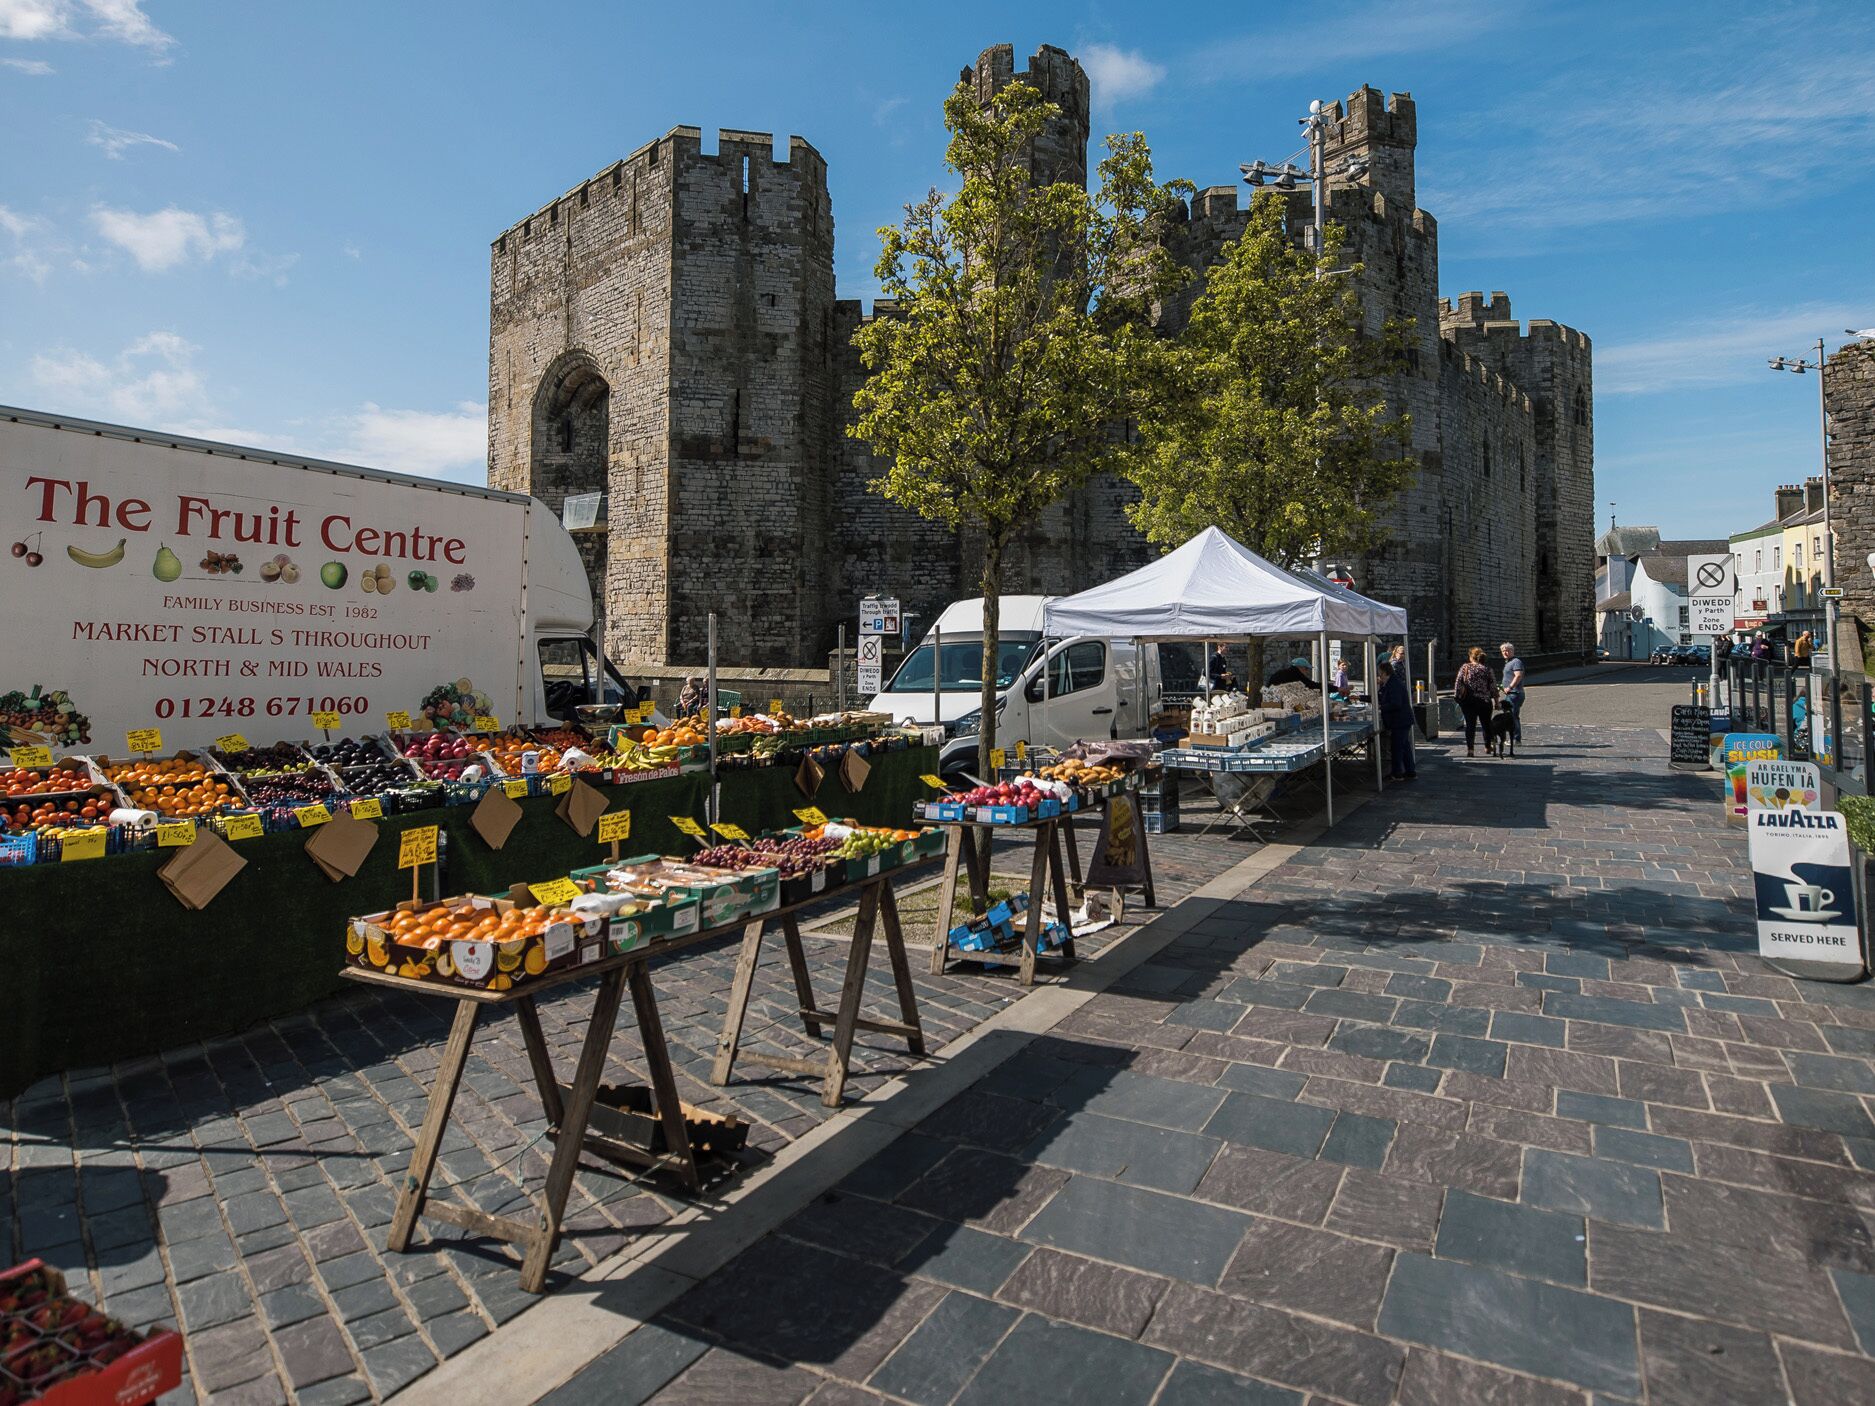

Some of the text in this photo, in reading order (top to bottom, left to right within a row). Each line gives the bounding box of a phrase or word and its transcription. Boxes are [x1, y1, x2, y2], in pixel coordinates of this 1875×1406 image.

[25, 476, 466, 564] The Fruit Centre
[163, 595, 378, 619] FAMILY BUSINESS EST 1982
[1692, 599, 1731, 607] DIWEDD
[72, 621, 184, 643] MARKET
[291, 630, 431, 649] THROUGHOUT
[1698, 623, 1725, 631] ENDS
[142, 658, 382, 678] NORTH & MID WALES
[155, 695, 370, 719] 01248 671060
[1733, 740, 1773, 750] ICE COLD
[1728, 749, 1778, 763] SLUSH
[1758, 763, 1807, 774] AR GAEL YMA
[1752, 772, 1795, 788] HUFEN
[1757, 809, 1838, 830] LAVAZZA
[1770, 932, 1847, 946] SERVED HERE
